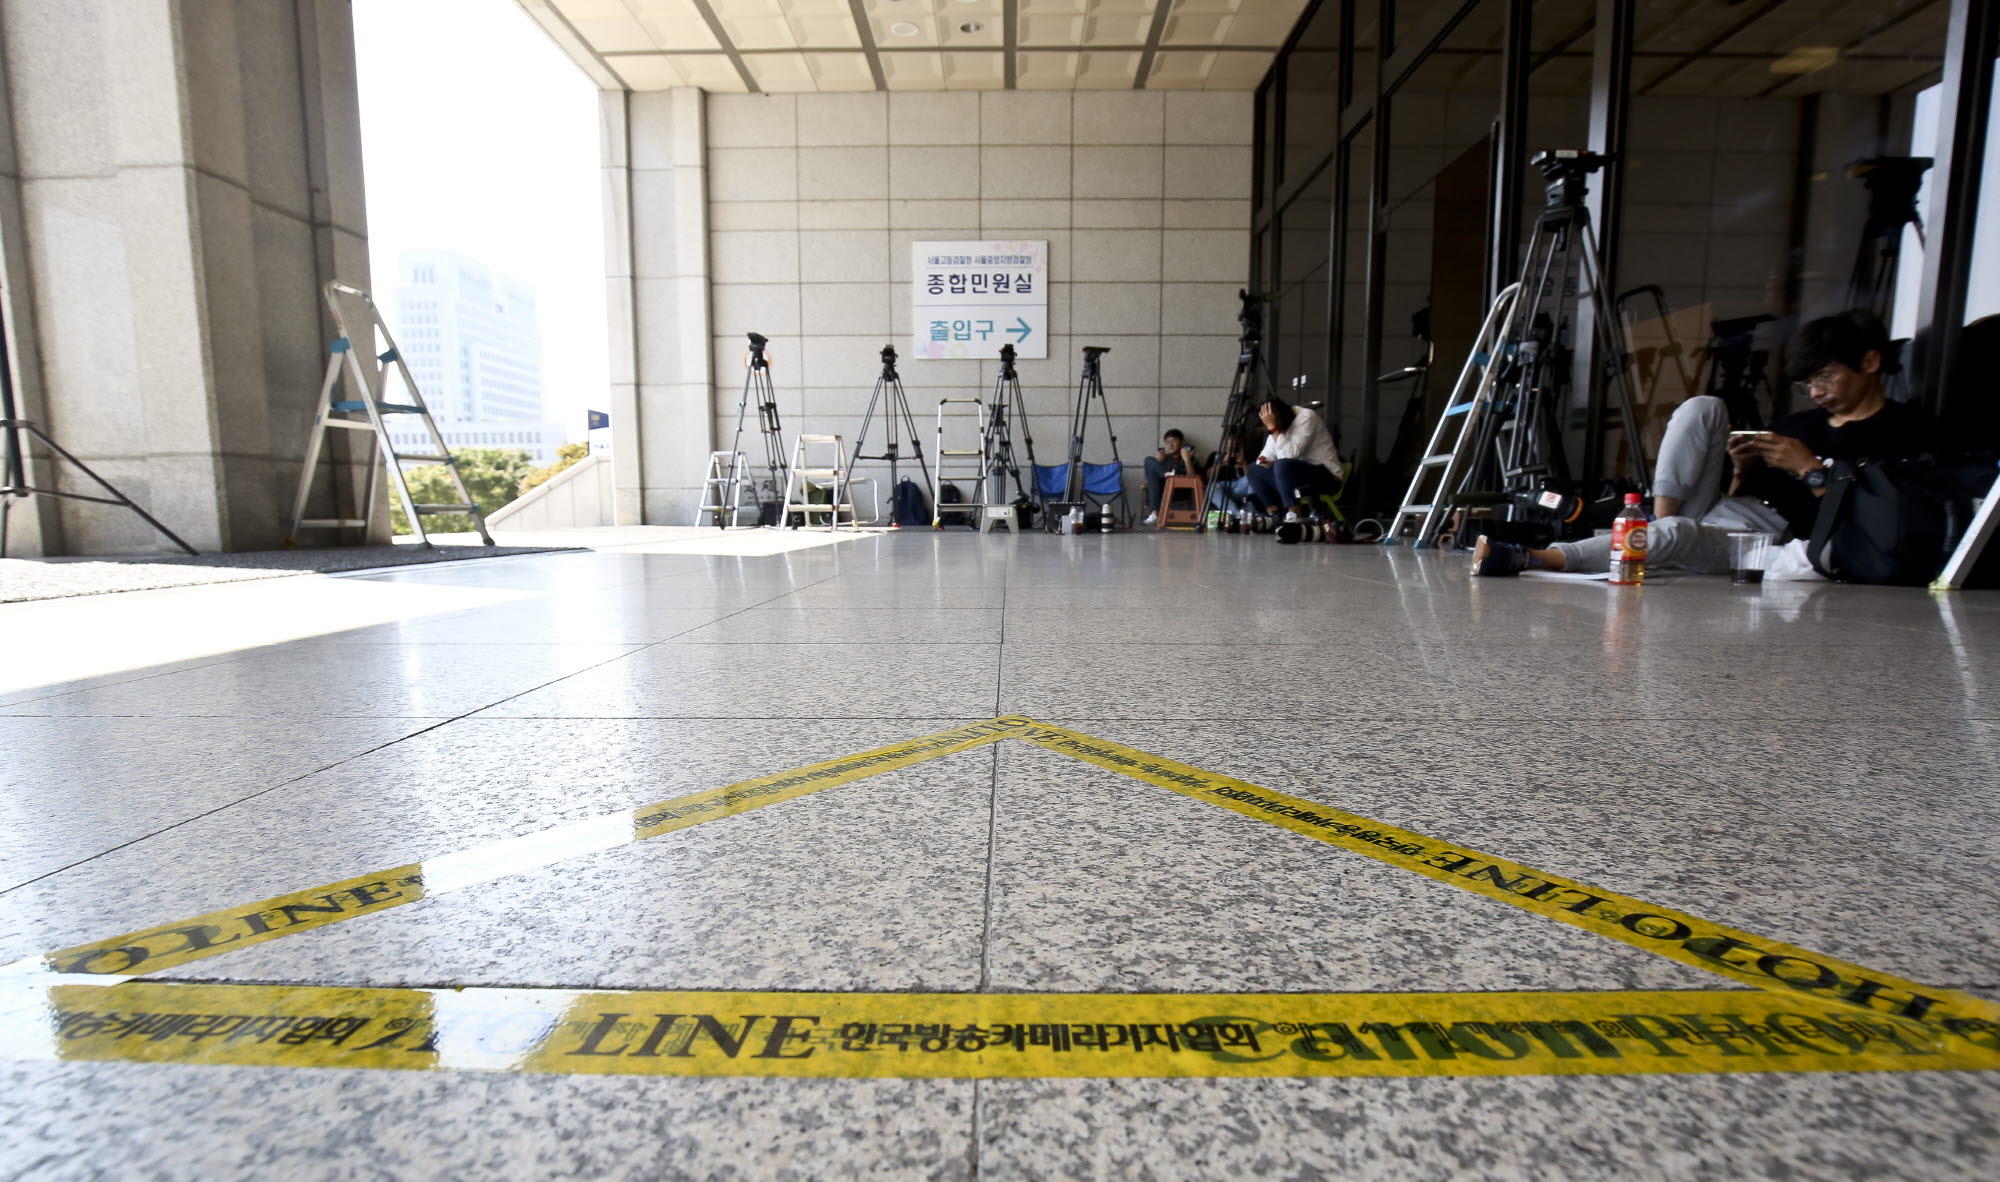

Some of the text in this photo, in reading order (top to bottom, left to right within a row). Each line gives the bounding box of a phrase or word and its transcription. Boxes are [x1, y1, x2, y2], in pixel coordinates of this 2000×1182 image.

[927, 273, 1032, 295] 종합민원실
[929, 319, 994, 341] 출입구
[1422, 851, 1613, 915] LINE
[175, 881, 403, 953] LINE
[566, 1014, 821, 1059] LINE
[840, 1022, 1262, 1052] 한국방송카메라기자협회
